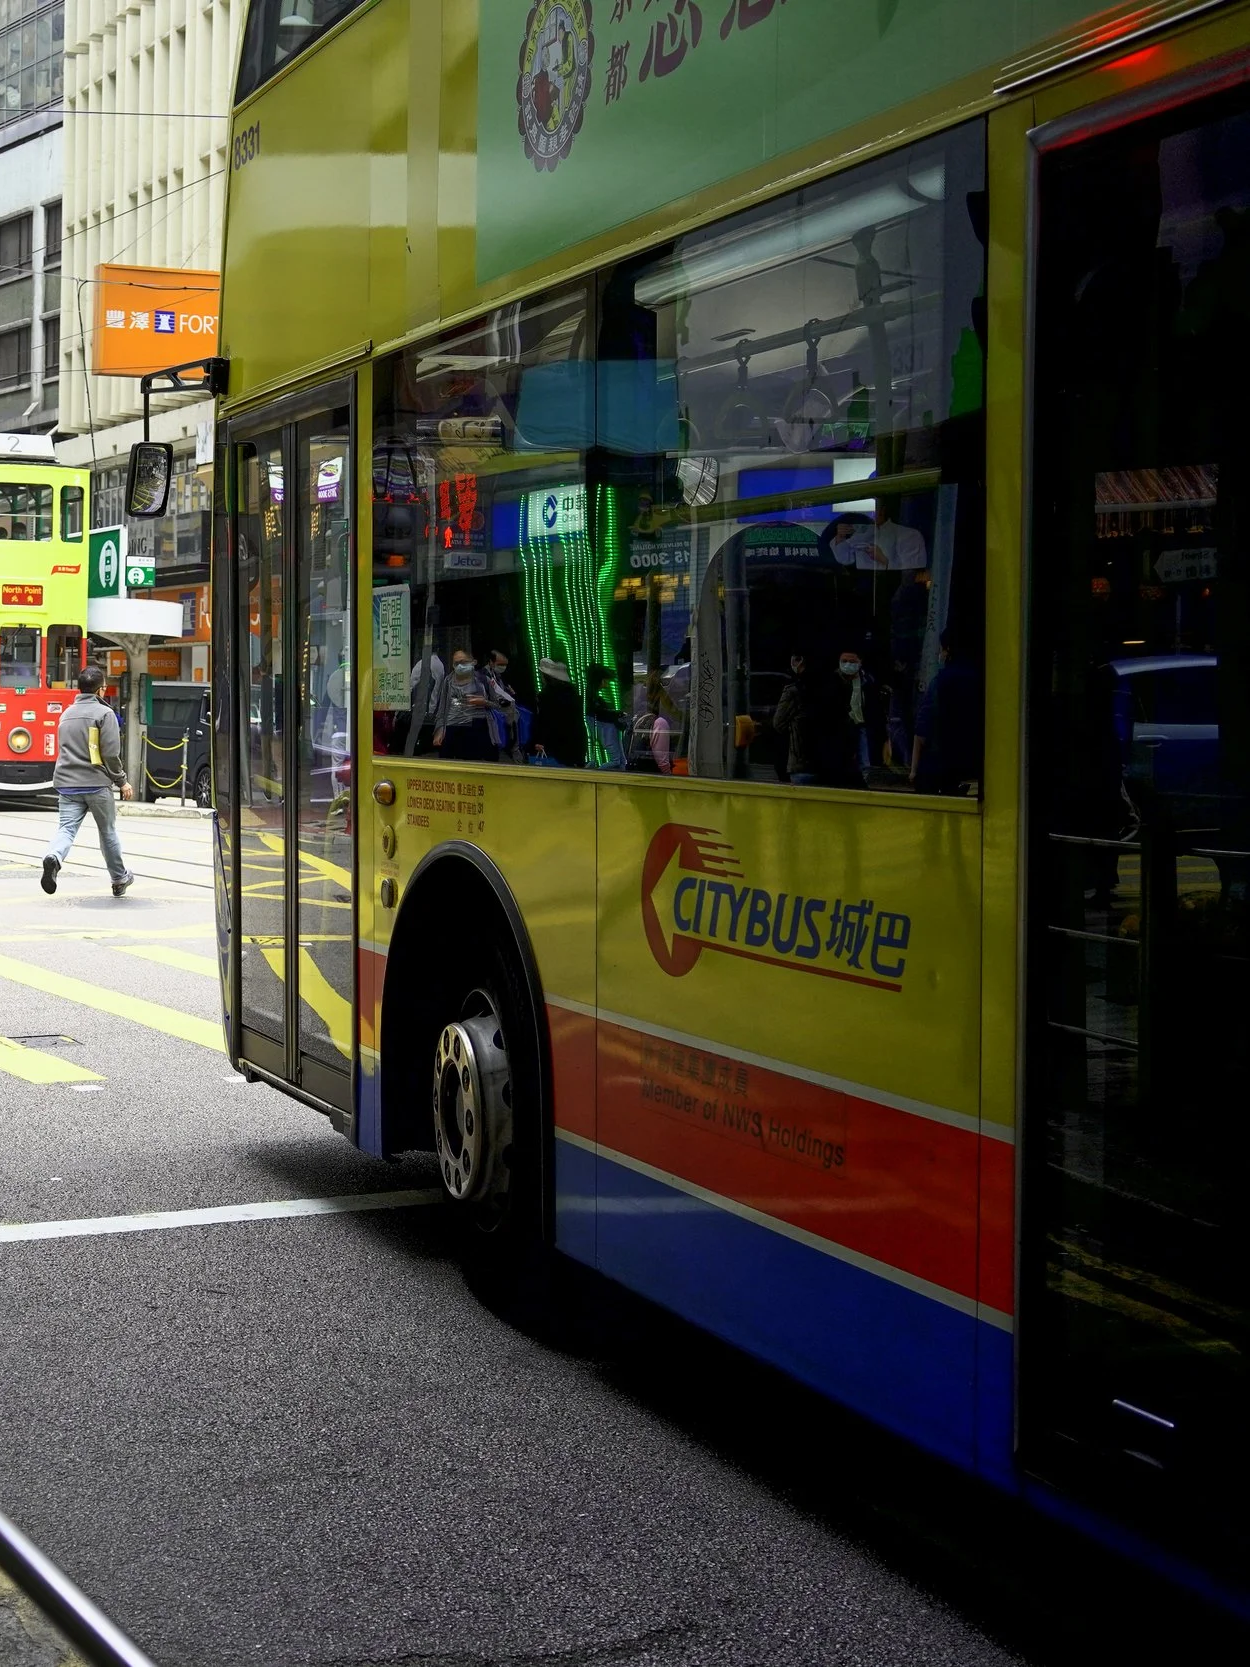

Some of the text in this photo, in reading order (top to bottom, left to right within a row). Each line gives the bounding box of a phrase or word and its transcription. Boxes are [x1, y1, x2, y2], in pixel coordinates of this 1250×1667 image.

[234, 120, 260, 170] 8331
[106, 310, 150, 330] 豐澤
[8, 435, 22, 452] 2
[3, 586, 22, 594] North
[148, 659, 177, 667] ORTRESS
[406, 779, 421, 791] UPPER
[422, 780, 435, 792] DECK
[435, 781, 455, 795] SEATING
[478, 784, 484, 797] 55
[407, 796, 422, 809] LOWER
[423, 798, 435, 810] DECK
[436, 799, 455, 813] SEATING
[478, 802, 484, 814] 31
[407, 813, 430, 828] STANDEES
[478, 820, 485, 832] 47
[673, 876, 911, 978] CITYBUS 城巴
[641, 1076, 845, 1168] Member of NWS Holdings
